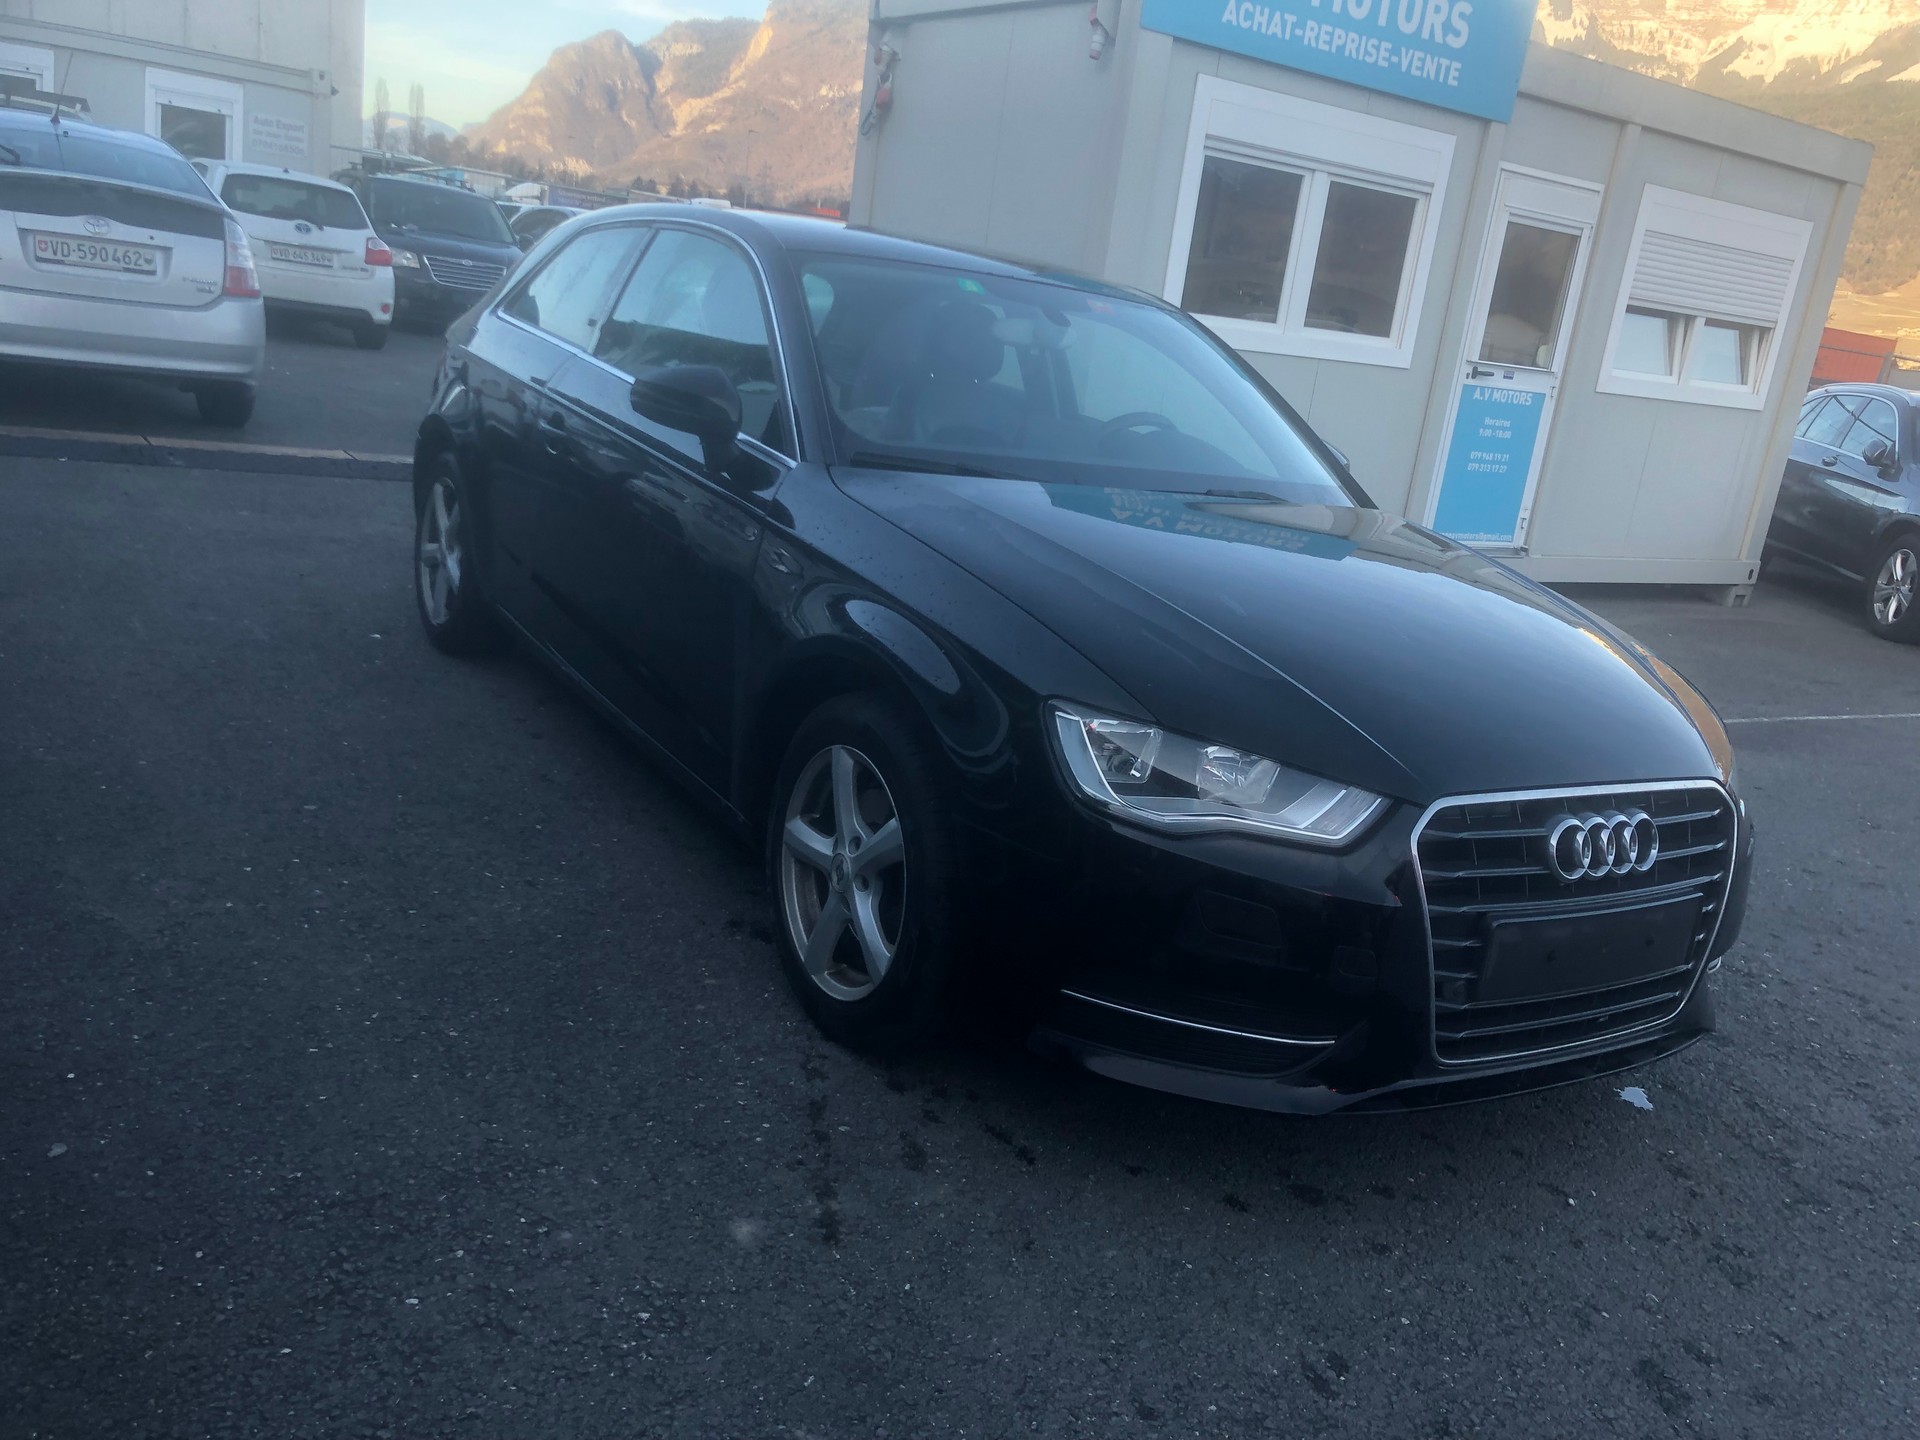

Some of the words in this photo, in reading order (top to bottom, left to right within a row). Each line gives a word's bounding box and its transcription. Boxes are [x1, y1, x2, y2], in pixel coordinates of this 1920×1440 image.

[1311, 0, 1473, 49] TORS
[1221, 0, 1463, 87] ACHAT-REPRISE-VENTE
[1492, 388, 1533, 406] MOTORS
[1484, 416, 1511, 428] Horaires
